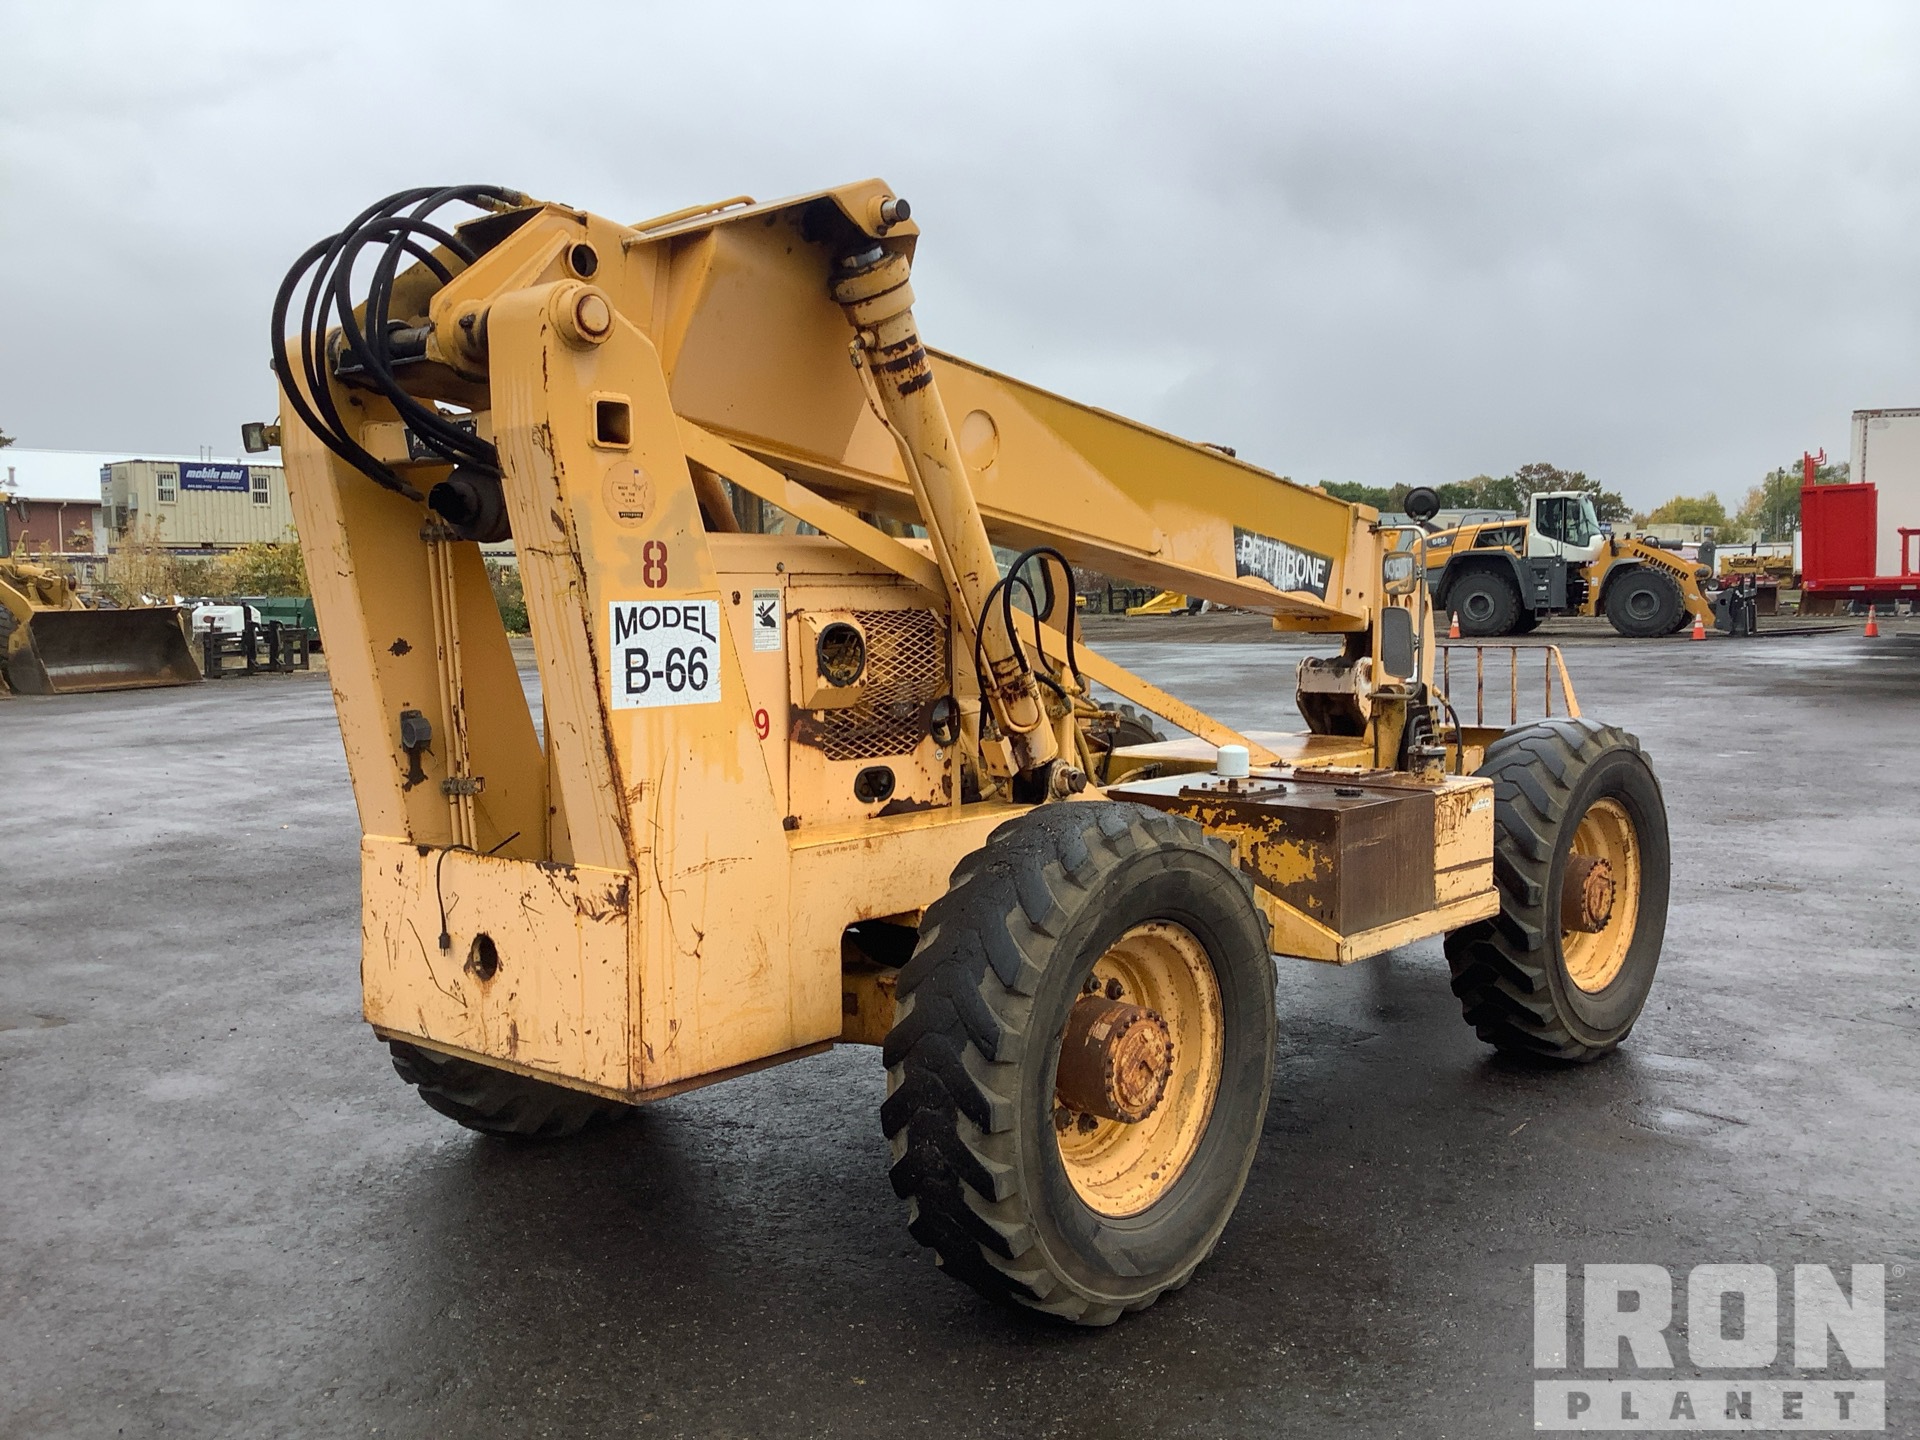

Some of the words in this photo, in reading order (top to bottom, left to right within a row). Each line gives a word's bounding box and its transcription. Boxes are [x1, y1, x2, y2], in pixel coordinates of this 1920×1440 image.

[186, 467, 220, 479] mobile
[220, 470, 243, 480] mini
[643, 541, 668, 588] 8
[1240, 534, 1326, 588] PETTIBONE
[1633, 549, 1689, 581] LIEBHERR
[615, 606, 716, 646] MODEL
[625, 646, 708, 694] B-66
[754, 709, 770, 740] 9
